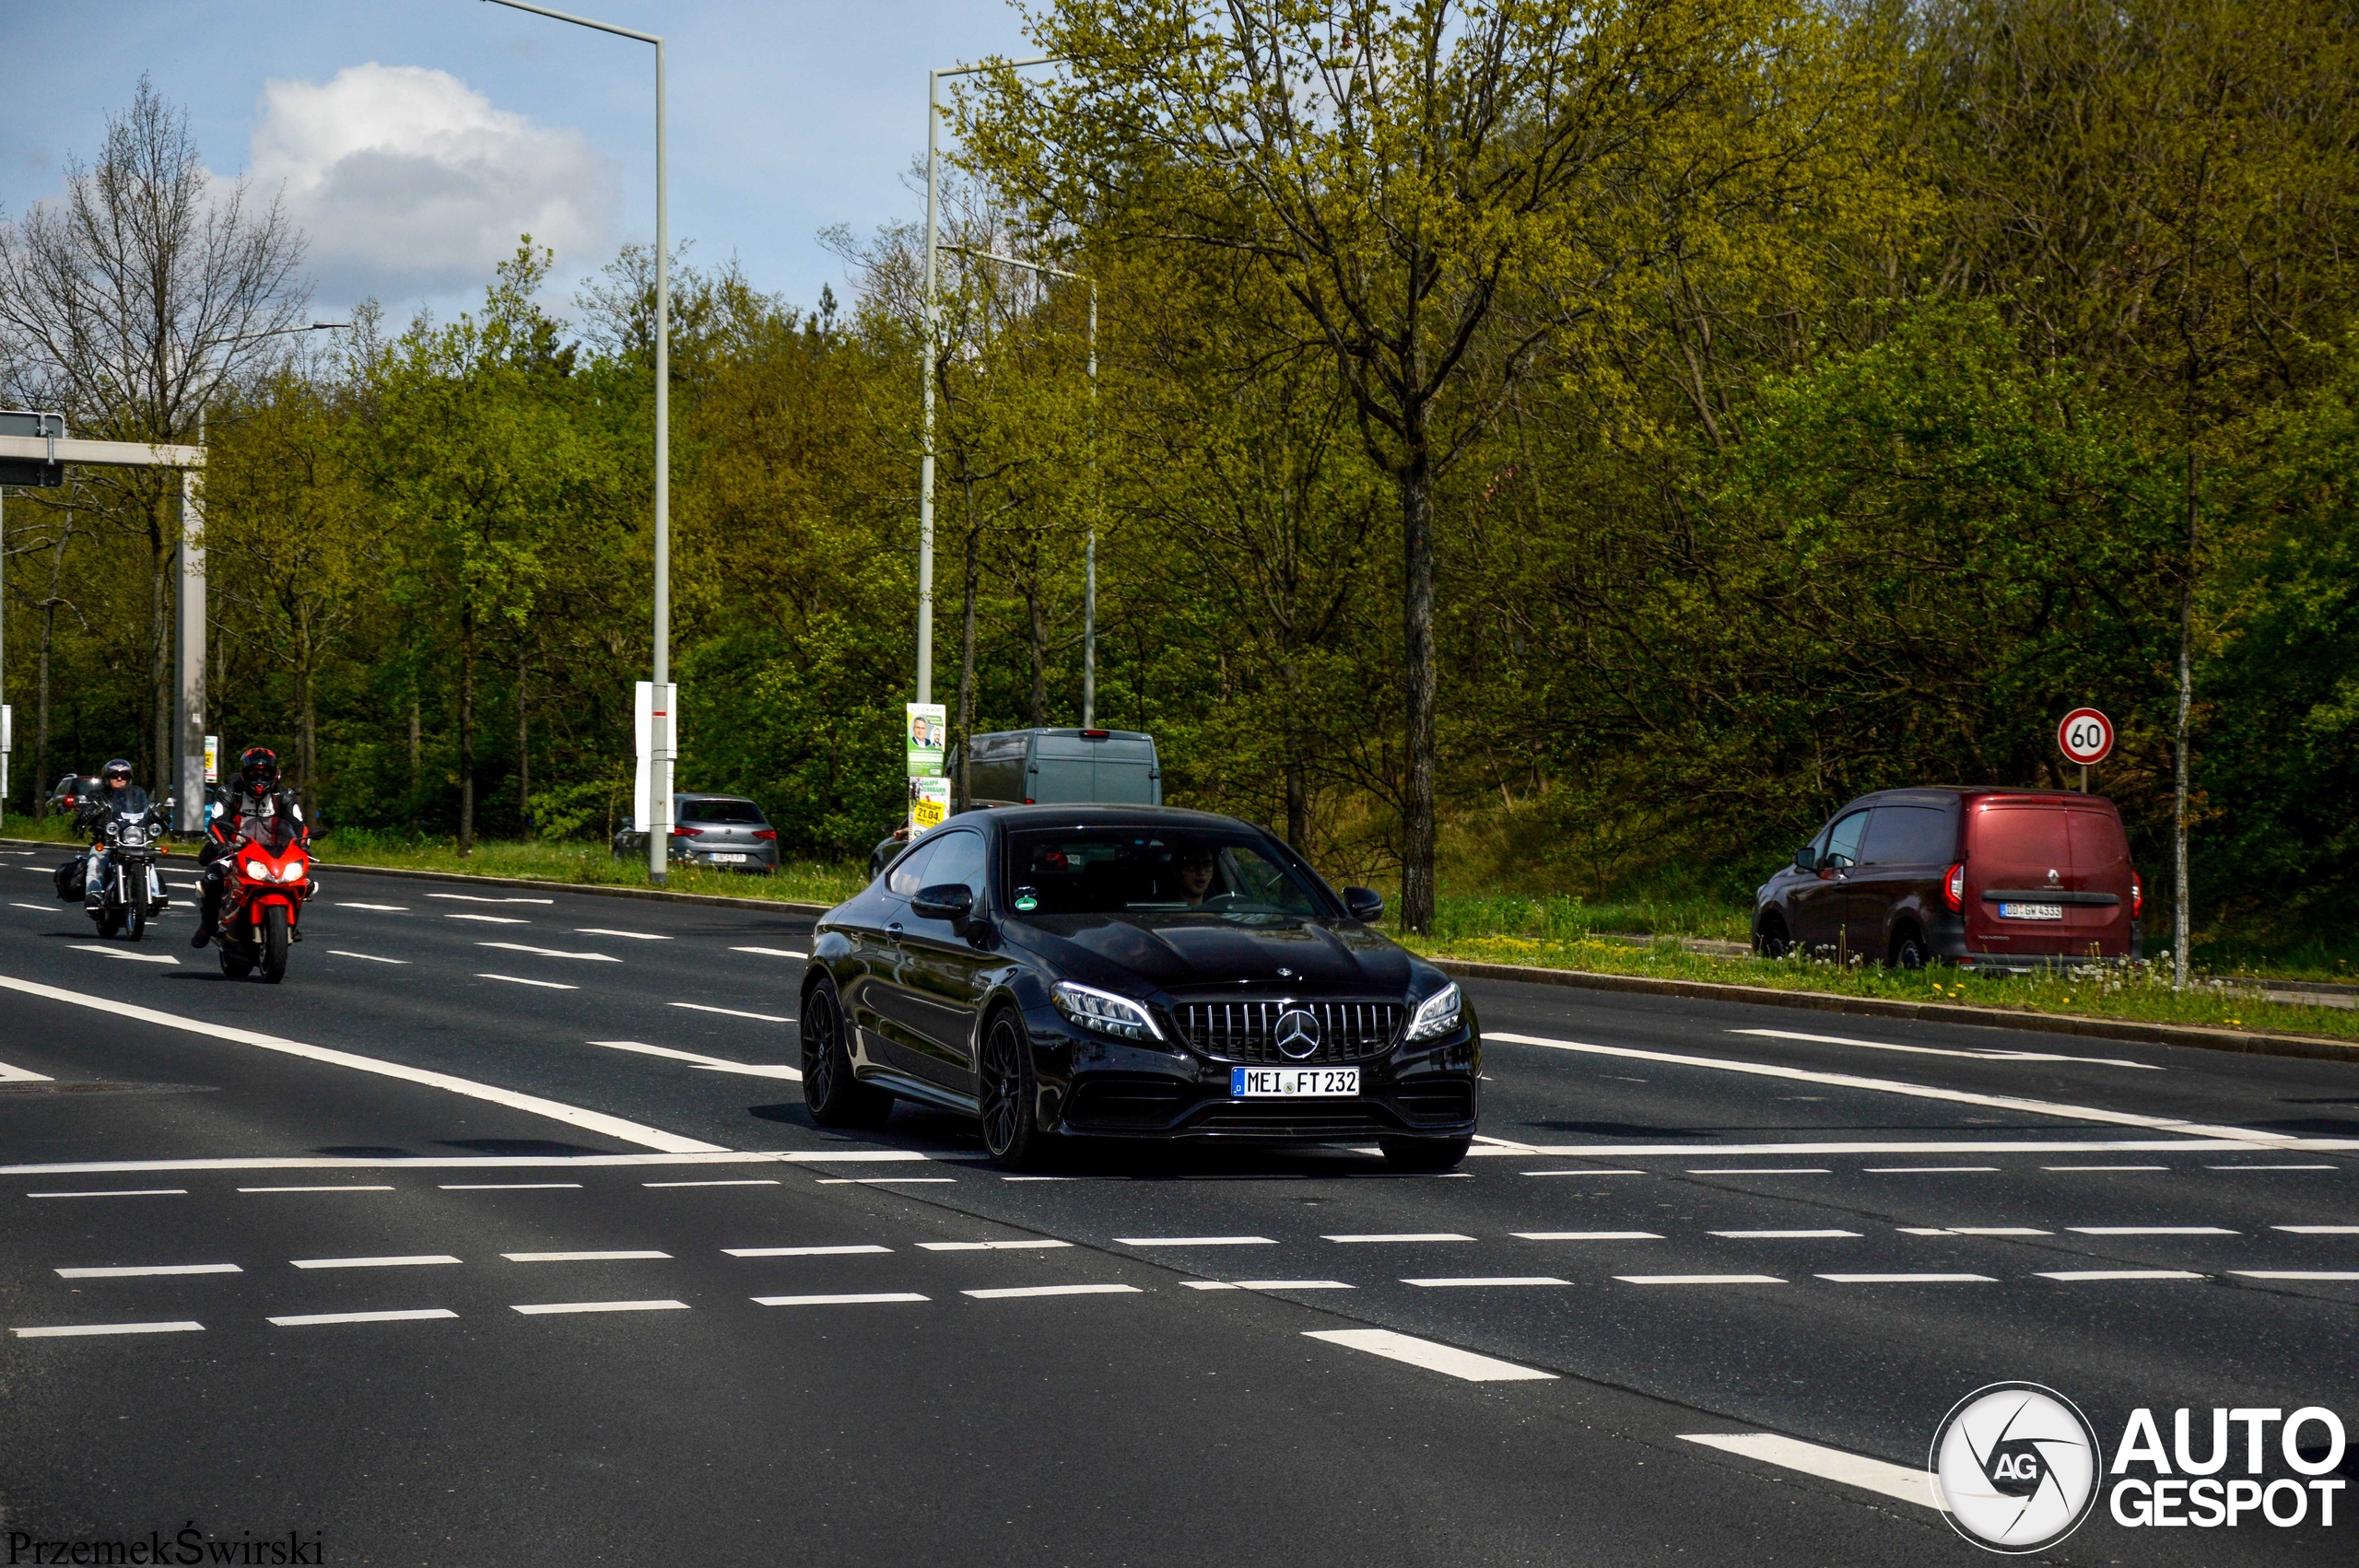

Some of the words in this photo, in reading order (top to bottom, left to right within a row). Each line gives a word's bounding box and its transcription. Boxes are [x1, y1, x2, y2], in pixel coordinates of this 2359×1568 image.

[2071, 724, 2100, 748] 60
[917, 807, 941, 822] 21.04.
[2007, 904, 2018, 915] DD
[2025, 906, 2036, 916] GW
[2039, 906, 2060, 917] 4333
[1247, 1071, 1282, 1093] MEI
[1297, 1071, 1320, 1093] FT
[1324, 1071, 1356, 1093] 232
